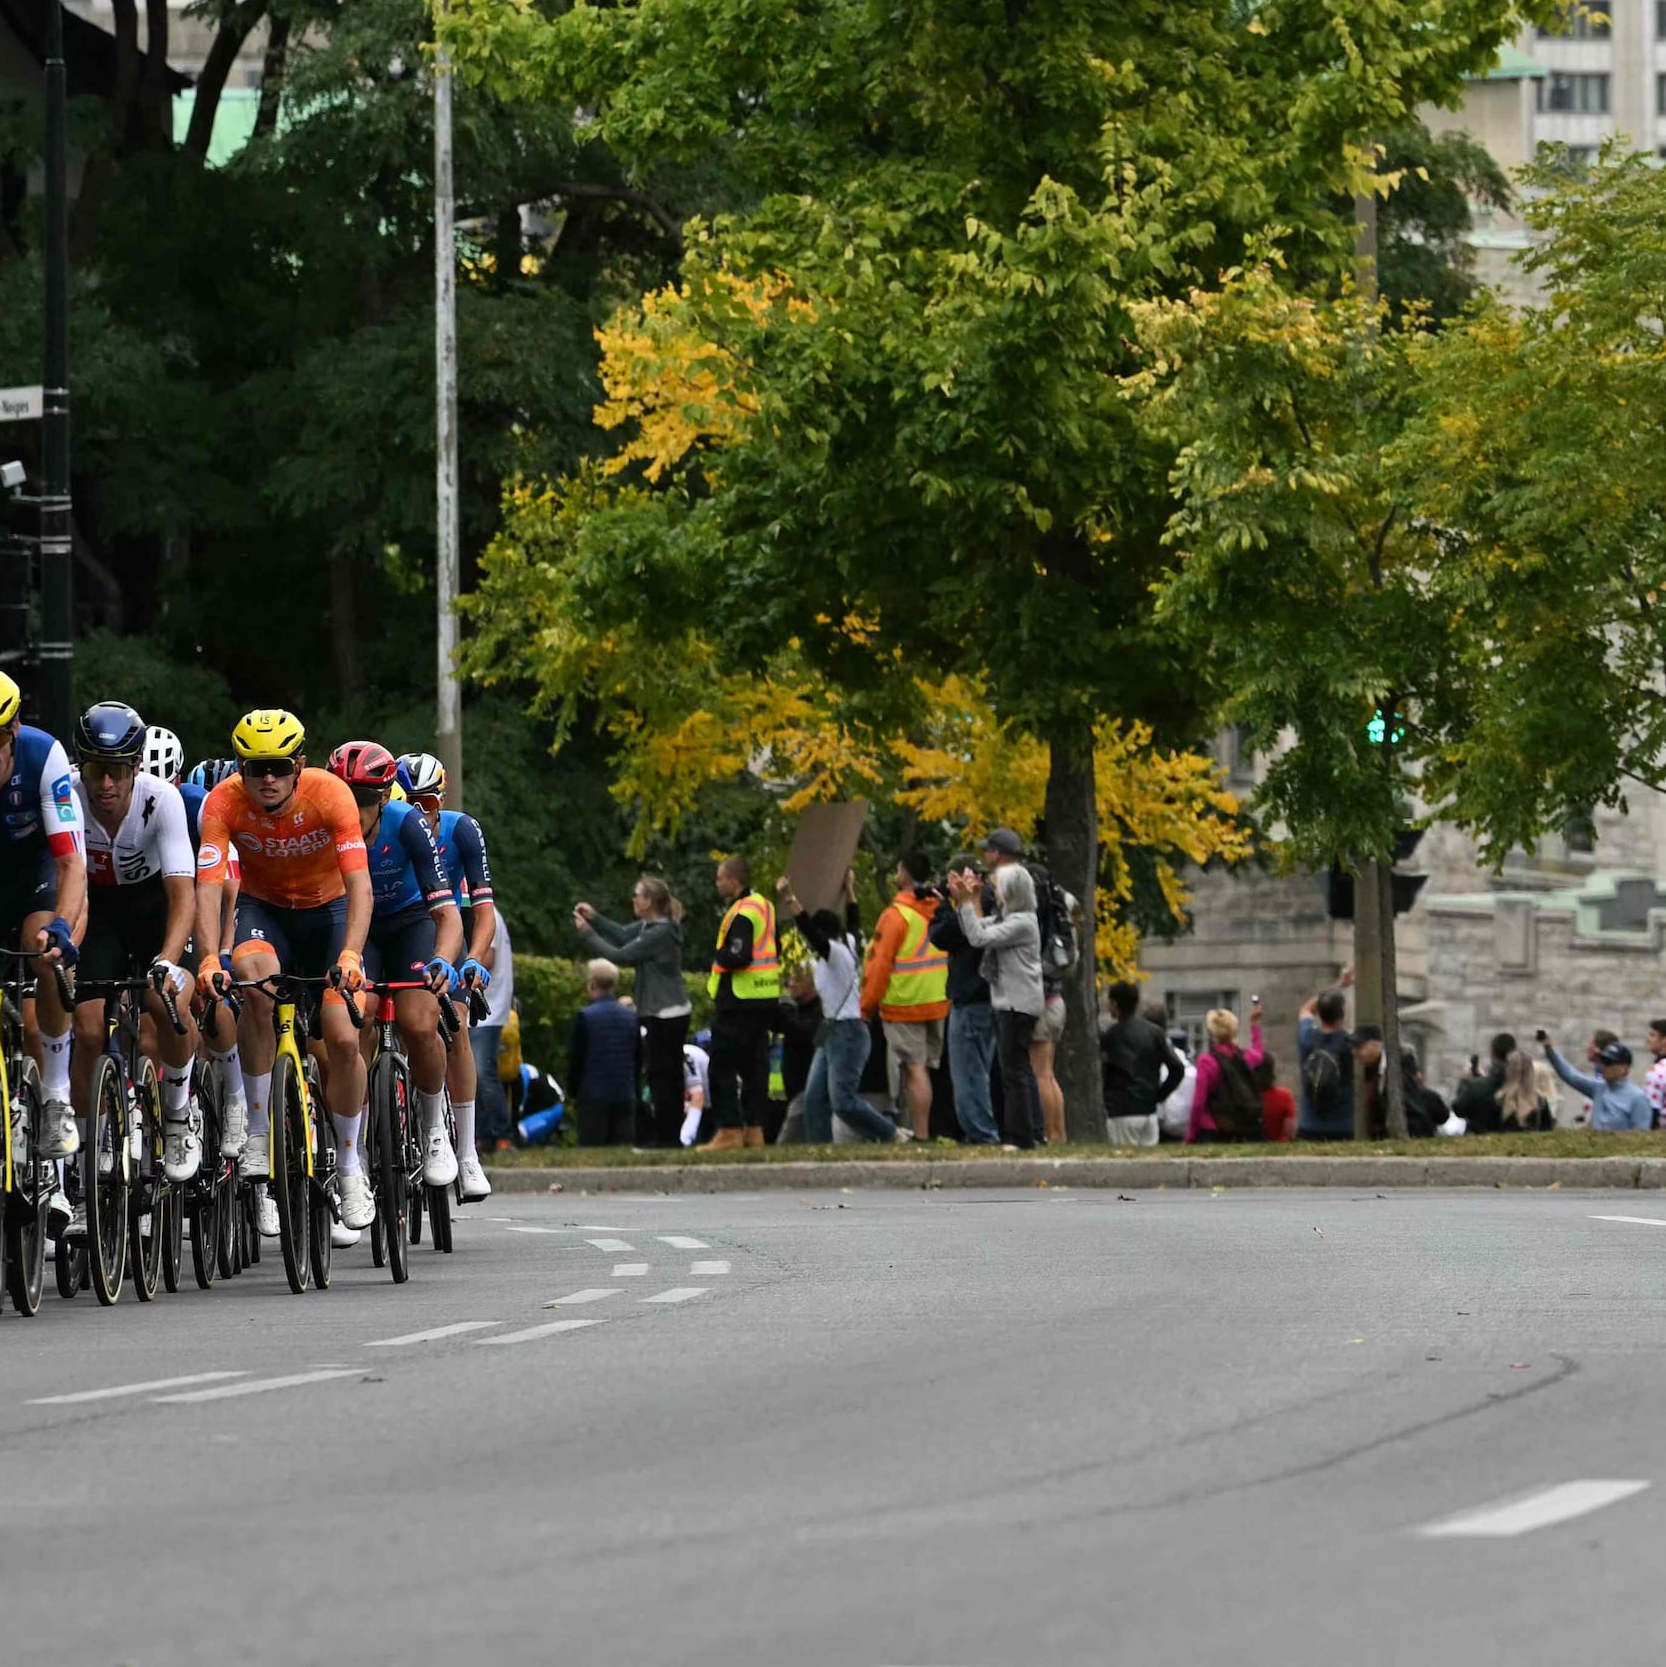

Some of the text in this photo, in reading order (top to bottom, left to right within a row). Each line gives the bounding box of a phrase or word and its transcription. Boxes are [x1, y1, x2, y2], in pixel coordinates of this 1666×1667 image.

[265, 828, 329, 849] STAATS
[418, 817, 448, 883] CASTELLI
[470, 818, 492, 882] CASTELLI
